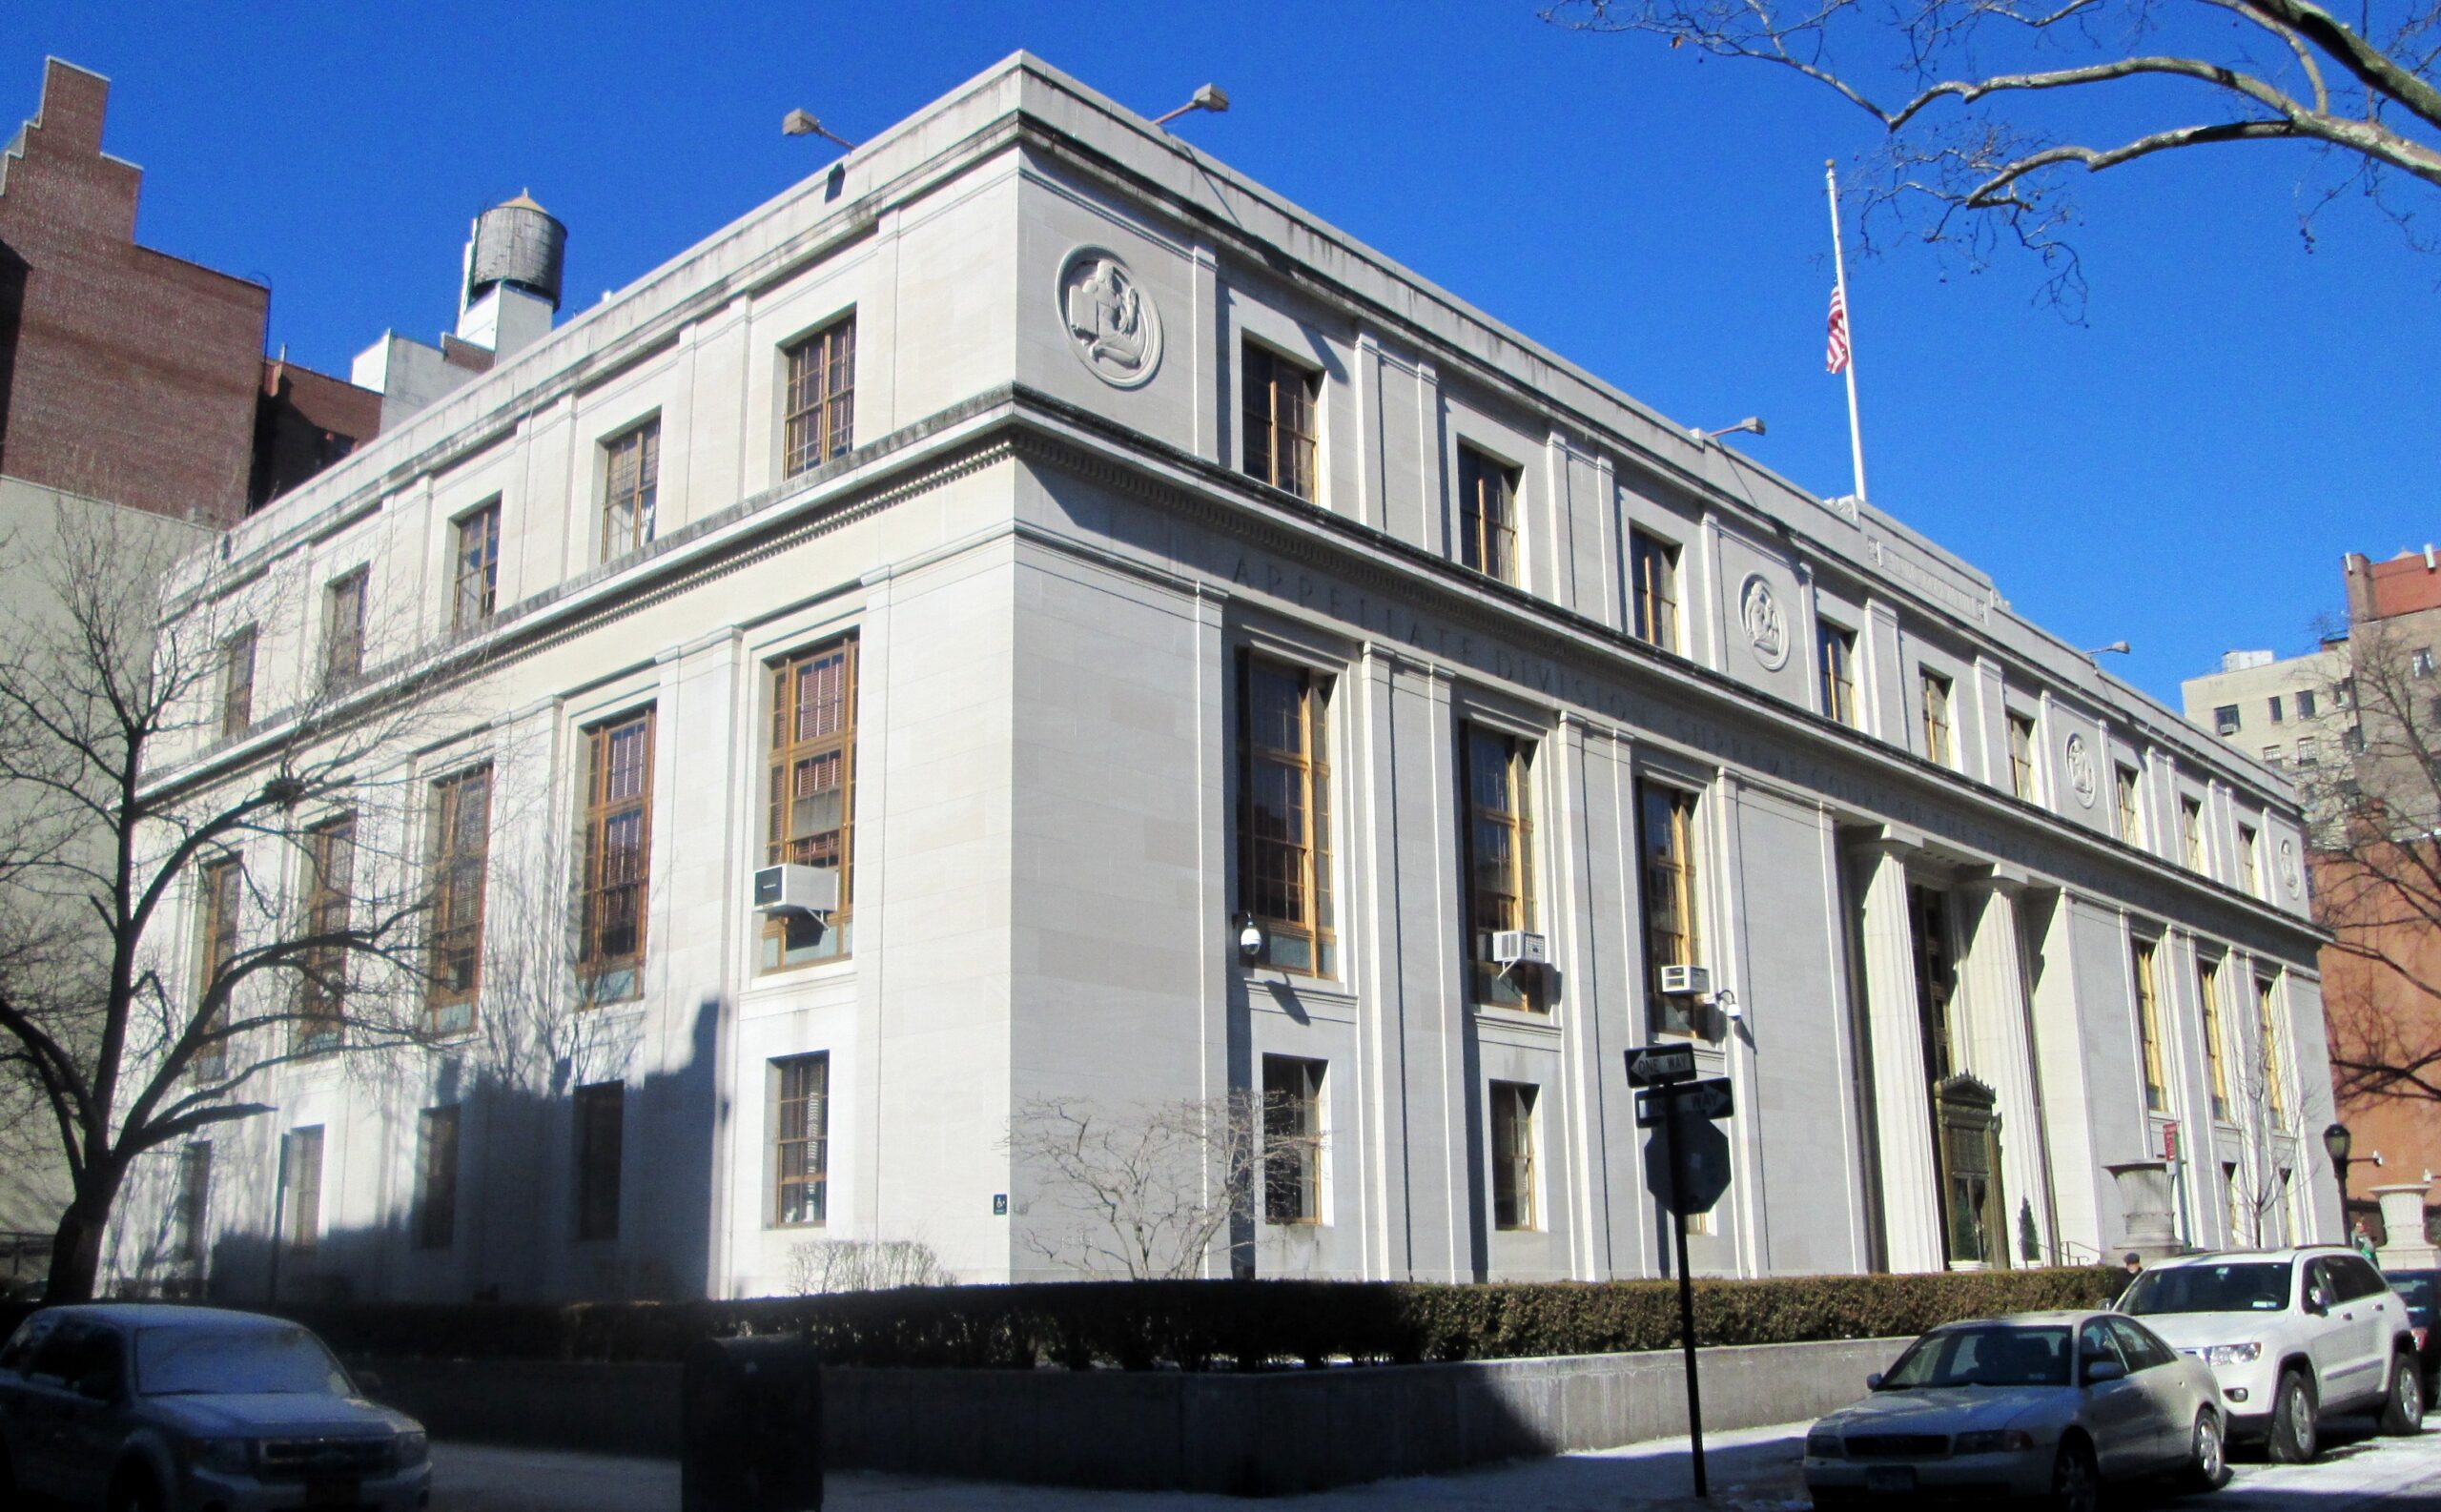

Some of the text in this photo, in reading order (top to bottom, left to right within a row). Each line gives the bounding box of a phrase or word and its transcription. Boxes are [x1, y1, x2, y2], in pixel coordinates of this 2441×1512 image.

[1233, 554, 1471, 666] APPELLATE
[1638, 1054, 1689, 1075] ONE WAY
[1692, 1093, 1718, 1109] WAY
